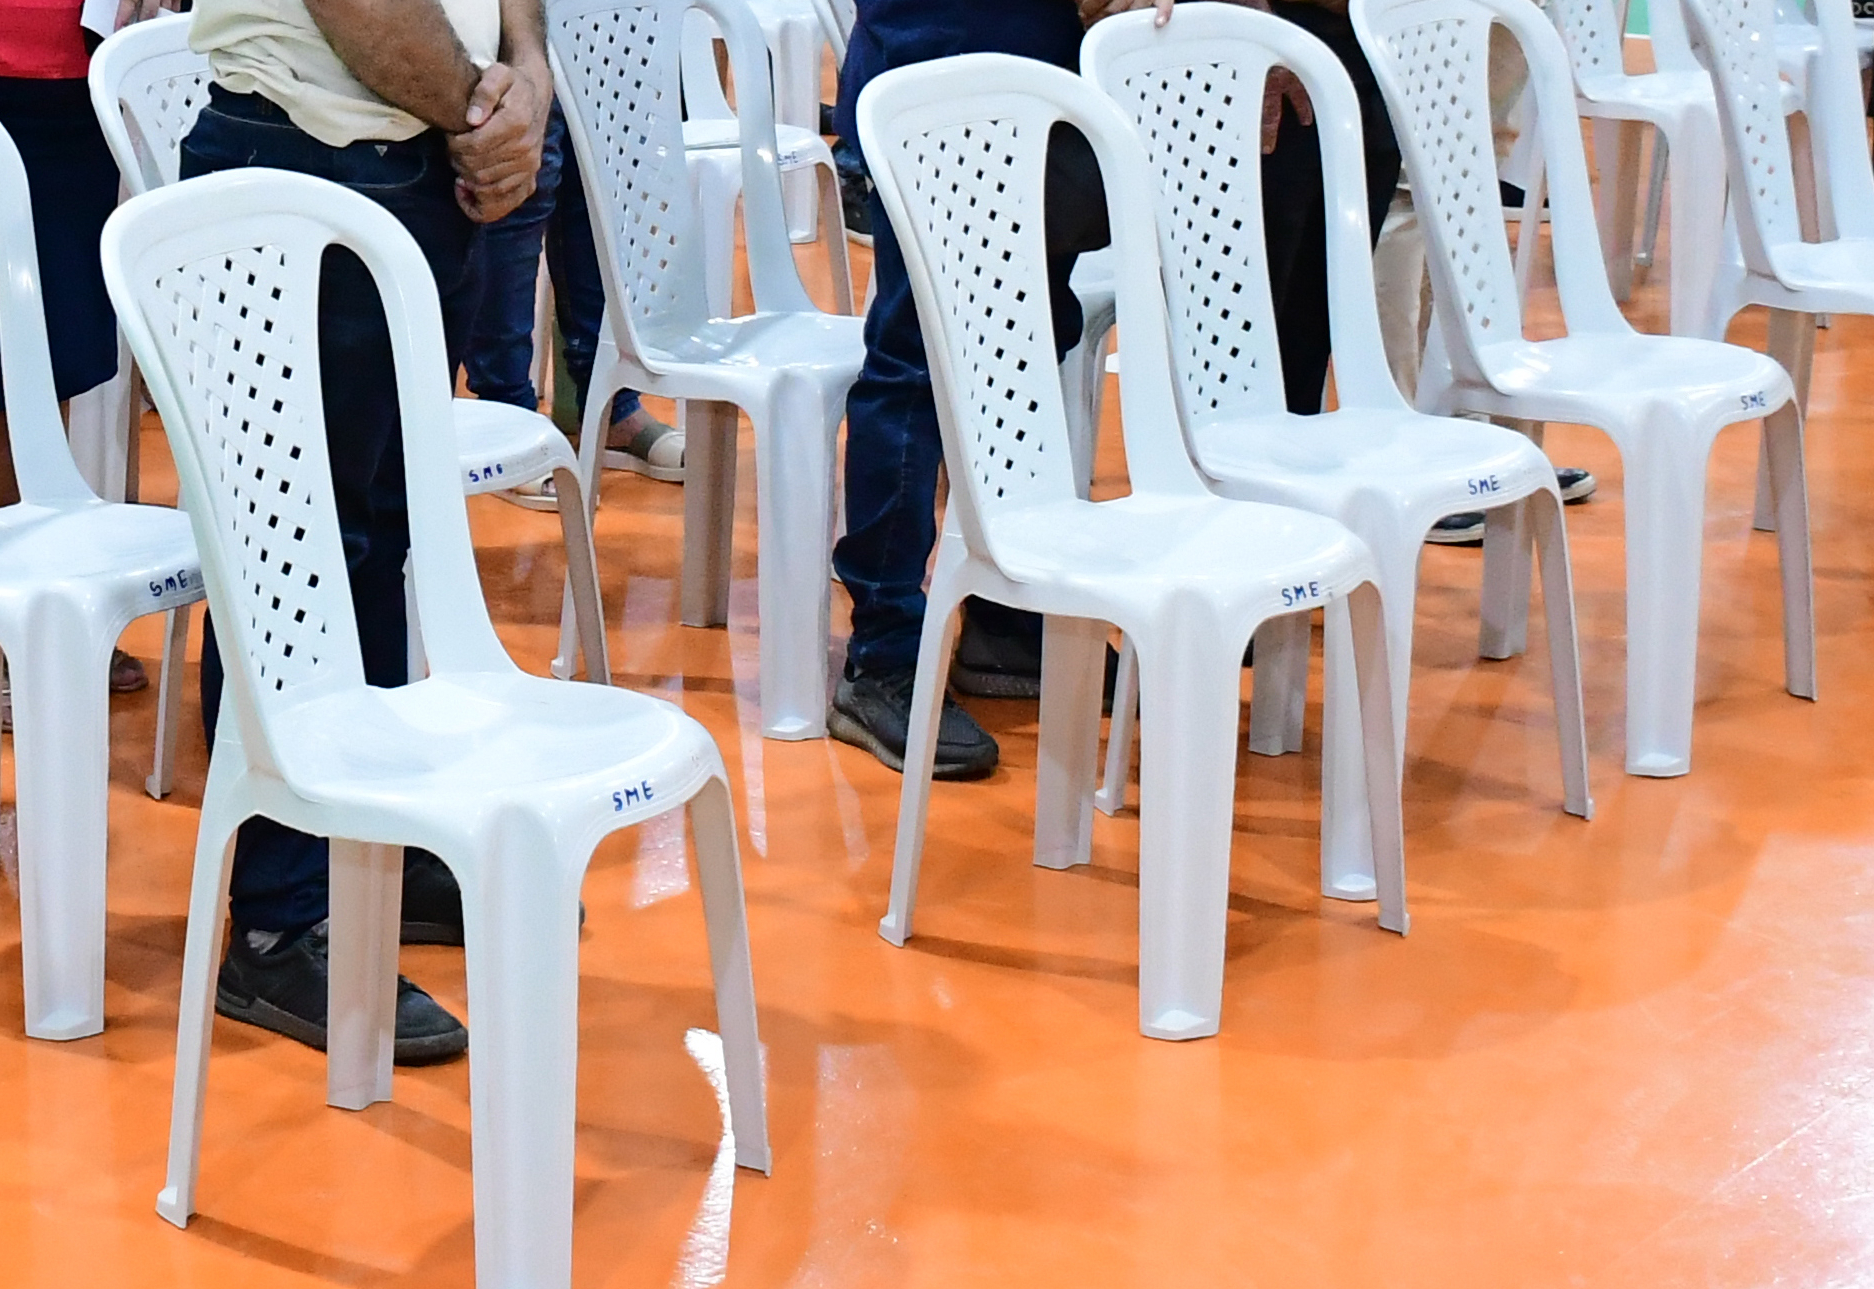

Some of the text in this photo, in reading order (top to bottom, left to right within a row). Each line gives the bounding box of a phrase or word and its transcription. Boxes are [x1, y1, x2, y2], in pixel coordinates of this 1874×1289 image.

[1740, 391, 1766, 411] SME
[1467, 474, 1501, 495] SME
[149, 569, 188, 597] SME
[1281, 581, 1320, 607] SME
[612, 779, 654, 812] SME
